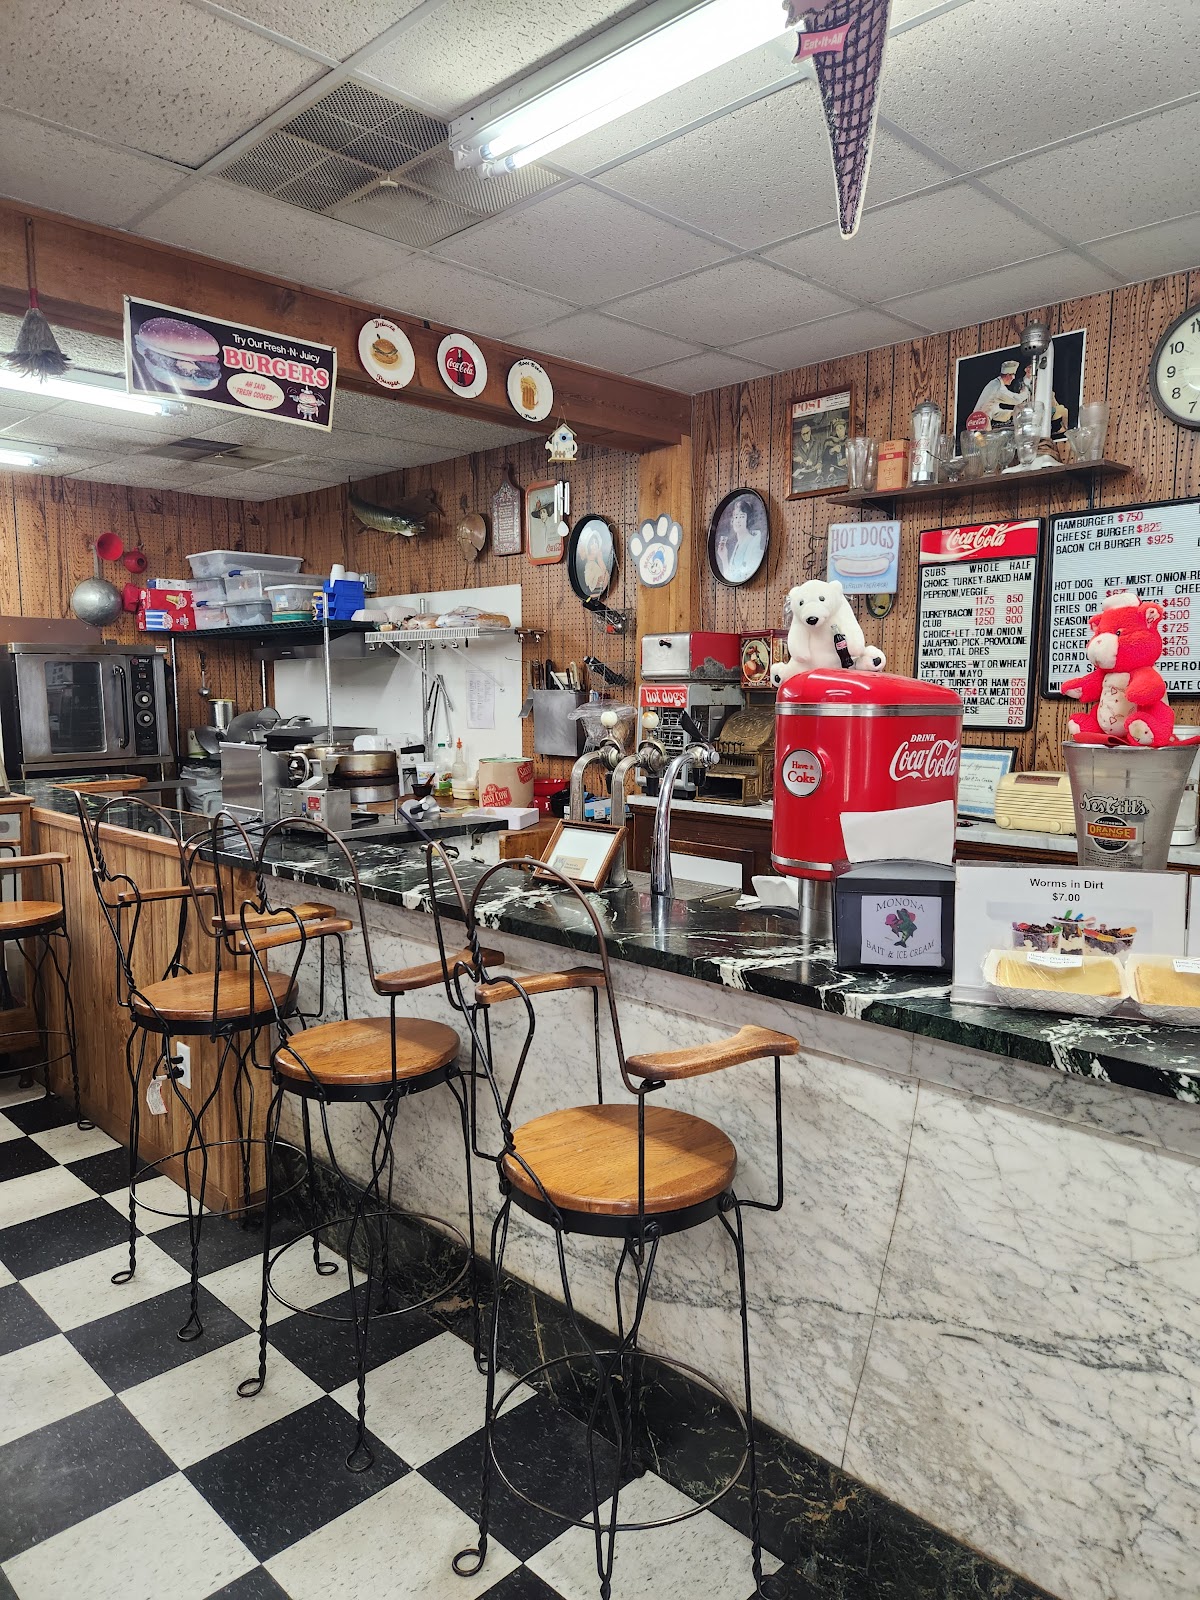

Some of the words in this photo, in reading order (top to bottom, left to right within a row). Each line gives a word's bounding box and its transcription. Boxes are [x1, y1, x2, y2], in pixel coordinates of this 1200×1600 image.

[232, 333, 247, 346] Try
[247, 337, 263, 348] Our
[263, 341, 286, 355] Fresh
[300, 350, 320, 364] Juicy
[1169, 341, 1185, 355] 10
[223, 346, 329, 389] BURGERS
[446, 357, 475, 376] Coca-Cola
[1166, 365, 1176, 378] 9
[245, 380, 254, 388] AH
[254, 382, 266, 391] SAID
[375, 373, 400, 387] Burger
[1171, 387, 1181, 399] 8
[1188, 400, 1198, 414] 7
[1057, 514, 1114, 531] HAMBURGER
[831, 527, 857, 554] HOT
[859, 525, 894, 549] DOGS
[946, 523, 1009, 551] Coca-Cola
[1056, 530, 1092, 543] CHEESE
[1096, 525, 1135, 538] BURGER
[1136, 522, 1162, 534] $825
[1056, 543, 1085, 555] BACON
[1088, 541, 1101, 551] CH
[1104, 537, 1141, 550] BURGER
[1147, 533, 1174, 545] $925
[924, 567, 946, 578] SUBS
[969, 563, 1000, 573] WHOLE
[1009, 560, 1031, 570] HALF
[923, 578, 949, 588] CHOICE
[1013, 572, 1032, 581] HAM
[1054, 580, 1072, 591] HOT
[1075, 579, 1093, 589] DOG
[1006, 594, 1023, 603] 850
[1078, 590, 1098, 601] DOG
[1136, 586, 1163, 597] WITH
[922, 610, 946, 619] TURKEY
[948, 608, 973, 618] BACON
[975, 607, 995, 616] 1250
[1005, 605, 1023, 615] 900
[1055, 604, 1080, 614] FRIES
[1085, 603, 1097, 613] OR
[1162, 597, 1191, 608] $450
[922, 619, 942, 628] CLUB
[974, 617, 995, 626] 1250
[1005, 615, 1023, 624] 900
[1053, 615, 1093, 626] SEASON
[1162, 610, 1190, 620] $500
[1052, 628, 1088, 638] CHEESE
[1161, 623, 1189, 633] $725
[1162, 636, 1188, 646] $475
[948, 647, 966, 656] ITAL
[968, 647, 990, 656] DRES
[1052, 652, 1089, 662] CORND
[1162, 647, 1190, 656] $500
[920, 660, 967, 669] SANDWICHES
[987, 660, 998, 668] OR
[999, 659, 1027, 668] WHEAT
[1052, 664, 1080, 673] PIZZA
[959, 669, 983, 678] MAYO
[948, 679, 975, 687] TURKEY
[977, 678, 988, 687] OR
[991, 678, 1009, 686] HAM
[1010, 678, 1026, 687] 675
[645, 688, 661, 704] hot
[662, 688, 686, 707] dogs
[978, 687, 987, 696] EX
[989, 687, 1010, 696] MEAT
[1010, 687, 1026, 697] 100
[1008, 706, 1024, 715] 675
[1007, 716, 1023, 725] 675
[910, 733, 937, 743] DRINK
[792, 760, 809, 770] Have
[889, 739, 959, 782] Coca-Cola
[787, 770, 816, 784] Coke
[1090, 825, 1132, 839] ORANGE
[1029, 878, 1067, 888] Worms
[1071, 880, 1081, 889] in
[1084, 880, 1104, 890] Dirt
[1052, 892, 1081, 902] $7.00
[876, 897, 925, 913] MONONA
[866, 939, 885, 956] BAIT
[887, 950, 894, 959] &
[896, 950, 908, 959] ICE
[909, 939, 935, 958] CREAM
